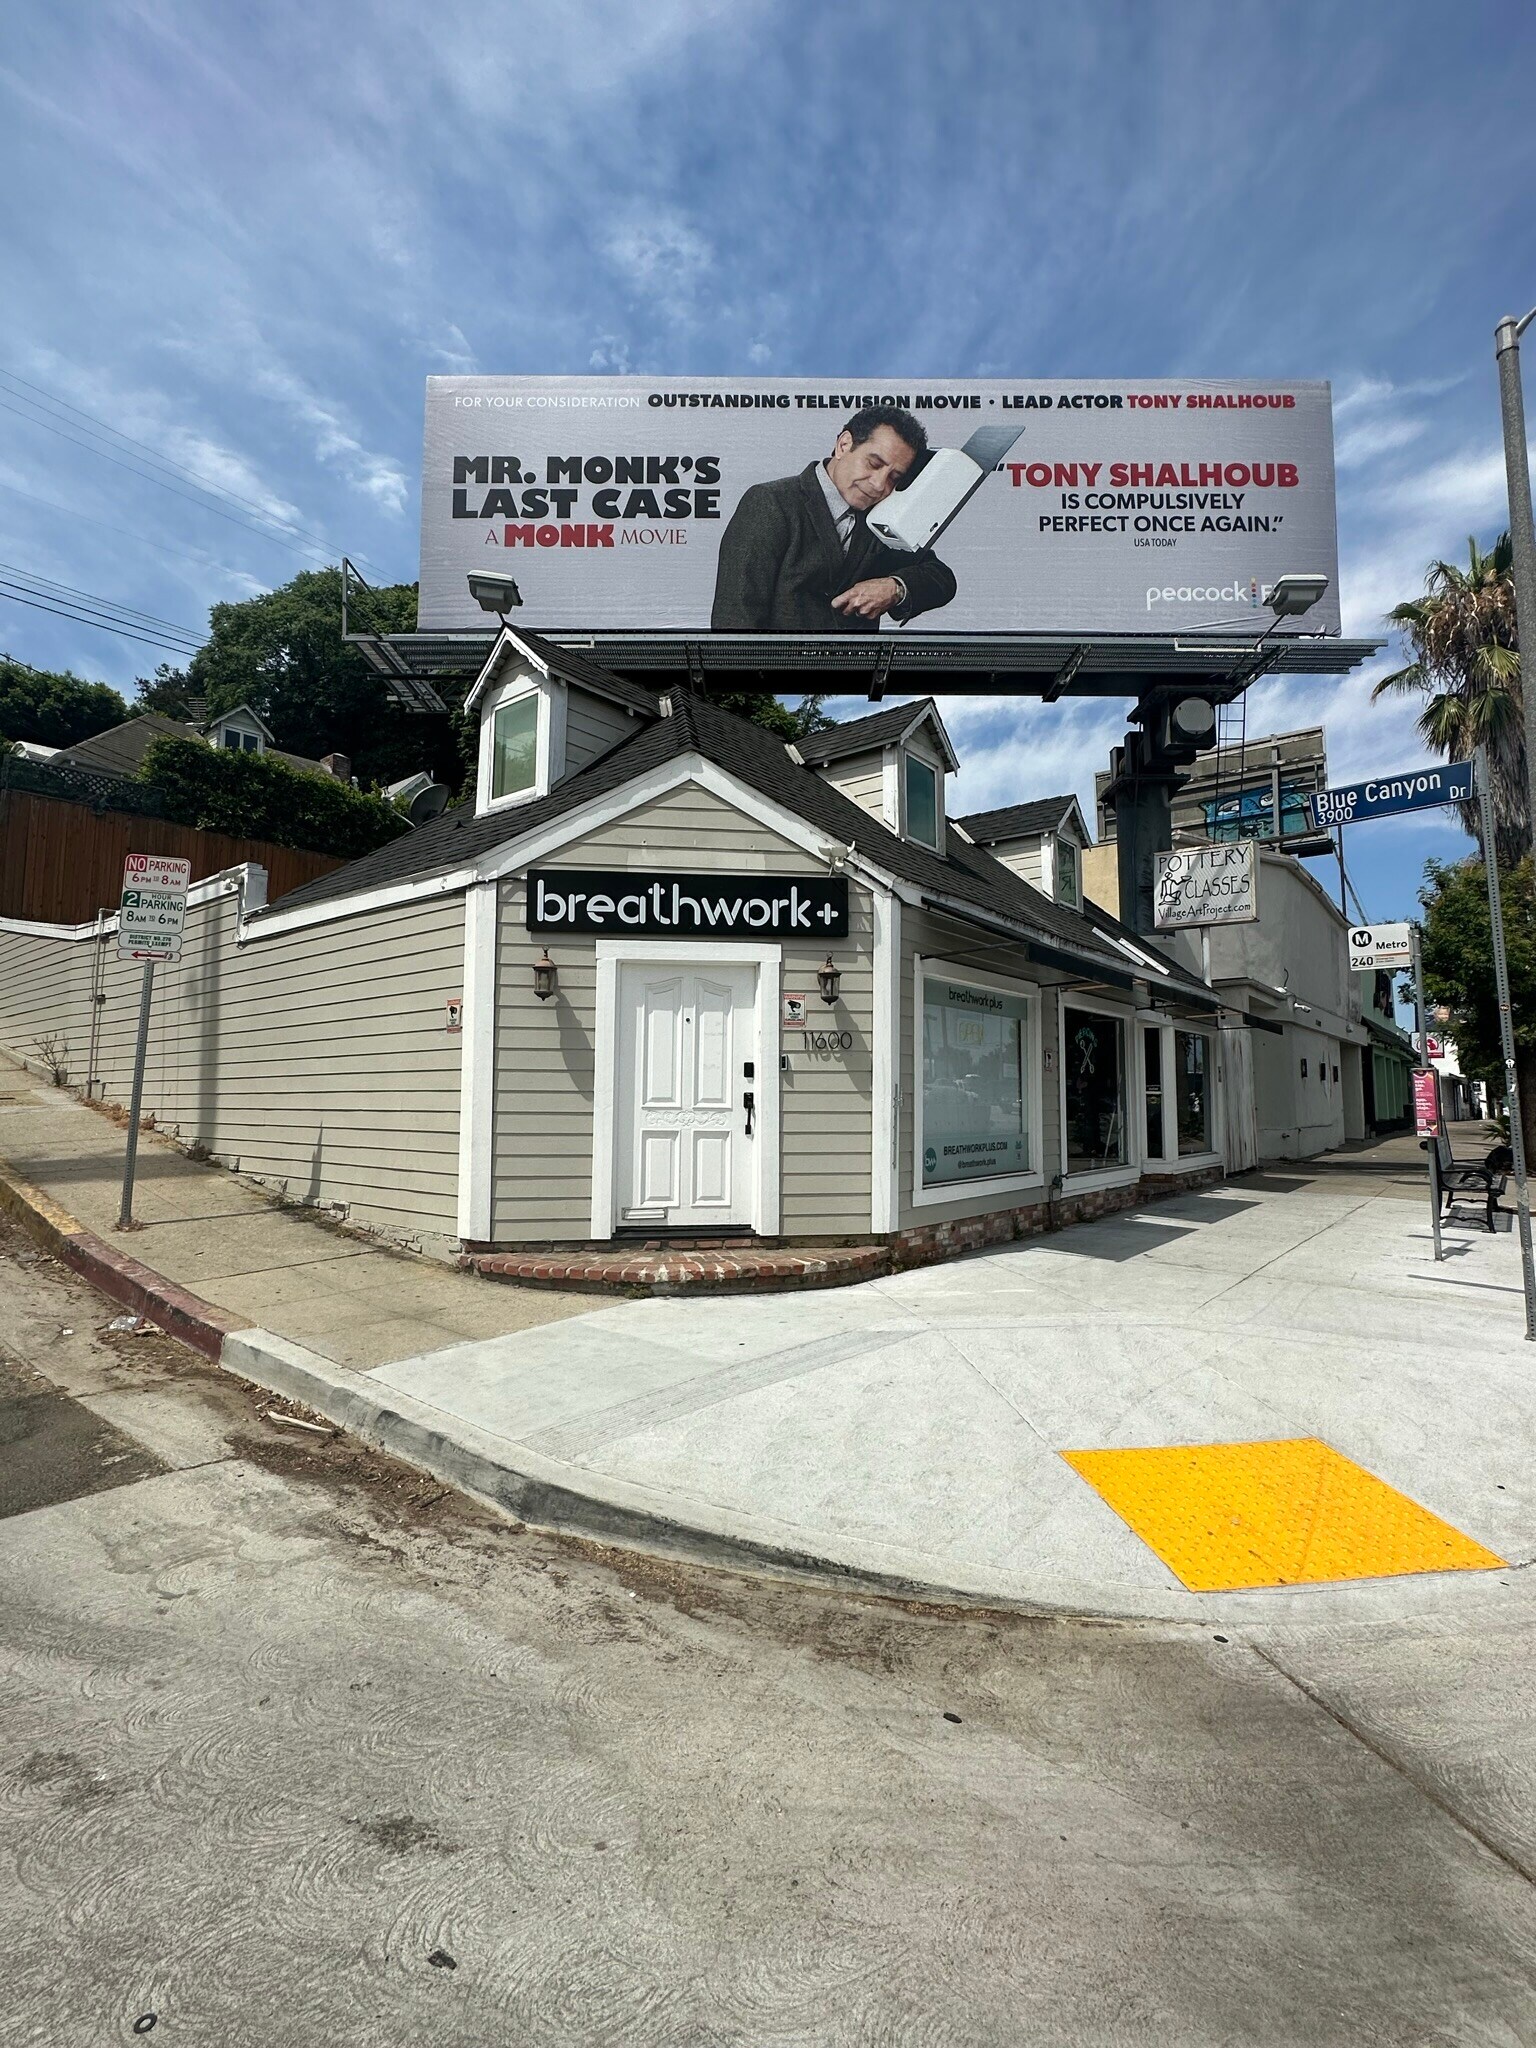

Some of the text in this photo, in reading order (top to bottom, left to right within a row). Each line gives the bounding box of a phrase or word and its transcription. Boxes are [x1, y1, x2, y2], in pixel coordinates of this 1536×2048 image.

[454, 393, 1295, 409] FOR YOUR CONSIDERATION OUTSTANDING TELEVISION MOVIE LEAD ACTOR TONY SHALHOUB
[453, 455, 721, 484] MR. MONK'S
[1109, 462, 1299, 488] SHALHOUB
[452, 488, 720, 519] LAST CASE
[1062, 493, 1245, 510] IS COMPULSIVELY
[1039, 515, 1129, 533] PERFECT
[1134, 515, 1196, 533] ONCE
[485, 524, 687, 548] A MONK MOVIE
[1134, 537, 1177, 548] USA TODAY
[1146, 580, 1248, 611] peacock
[1316, 773, 1467, 813] Blue Canyon Dr
[1318, 807, 1353, 825] 3900
[128, 857, 187, 874] NO PARKING
[1158, 846, 1249, 874] POTTERY
[1185, 874, 1250, 899] CLASSES
[126, 892, 139, 906] 2
[140, 899, 183, 912] PARKING
[1158, 903, 1251, 921] VillageArtProject.com
[1355, 932, 1369, 945] M
[1375, 941, 1408, 950] Metro
[1351, 956, 1374, 967] 240
[802, 1031, 853, 1050] 11600
[943, 1141, 1008, 1156] BREATHWORKPLUS.COM
